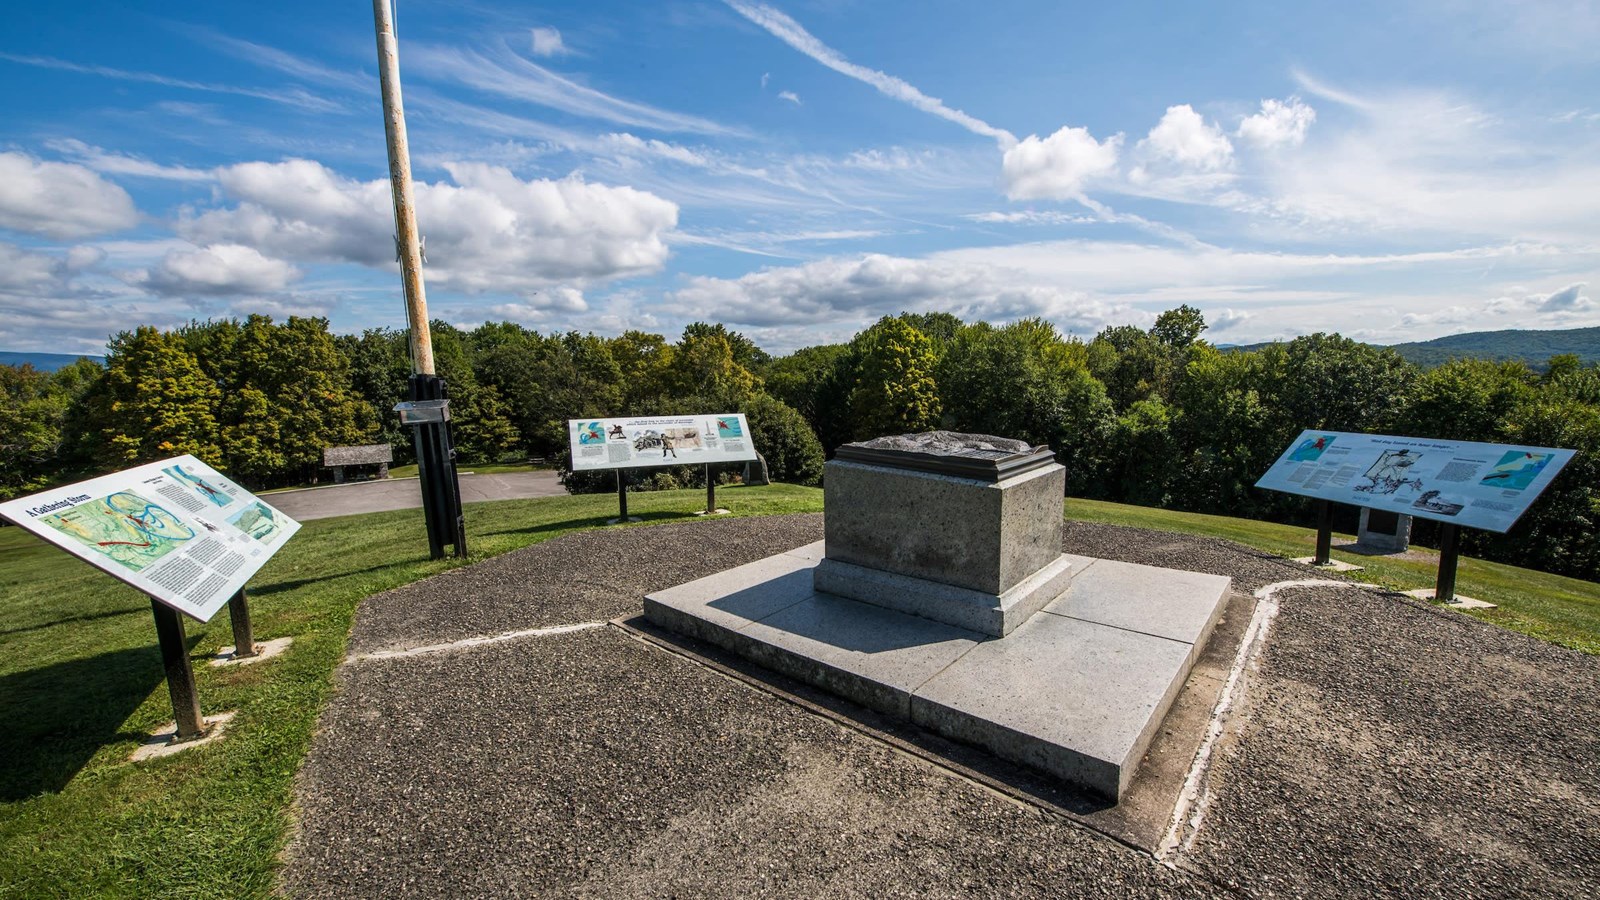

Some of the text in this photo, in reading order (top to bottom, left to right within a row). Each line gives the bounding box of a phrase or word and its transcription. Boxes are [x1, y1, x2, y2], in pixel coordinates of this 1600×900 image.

[25, 509, 38, 517] A
[32, 500, 75, 515] Gathering
[67, 494, 92, 503] Storm
